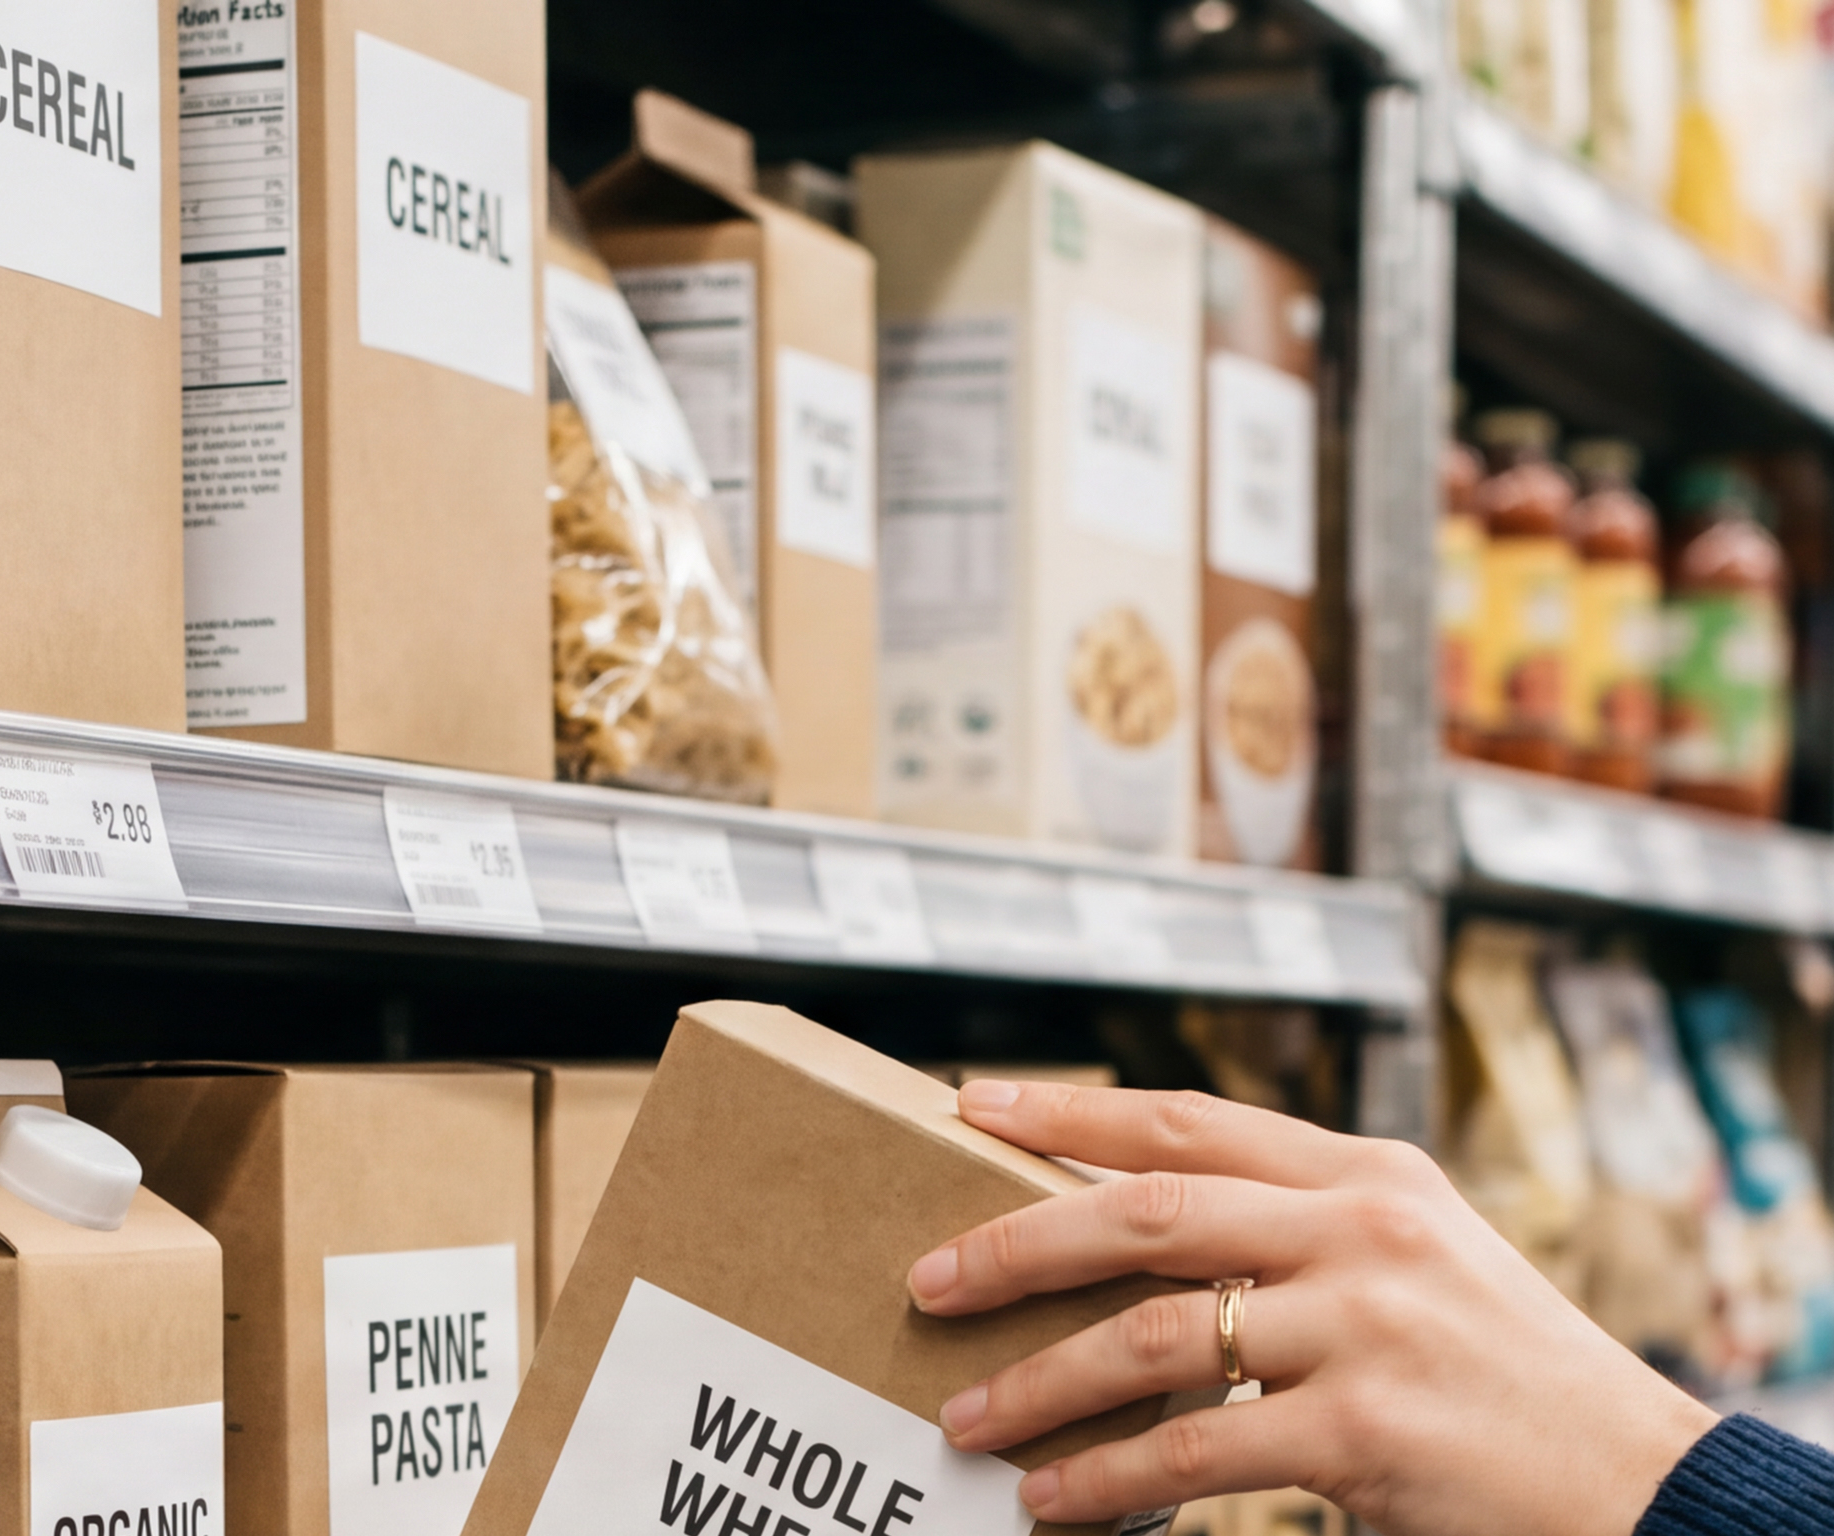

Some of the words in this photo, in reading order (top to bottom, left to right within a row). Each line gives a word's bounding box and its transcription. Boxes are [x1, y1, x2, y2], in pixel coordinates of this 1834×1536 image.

[386, 156, 511, 266] CEREAL
[368, 1311, 488, 1394] PENNE
[371, 1402, 486, 1486] PASTA
